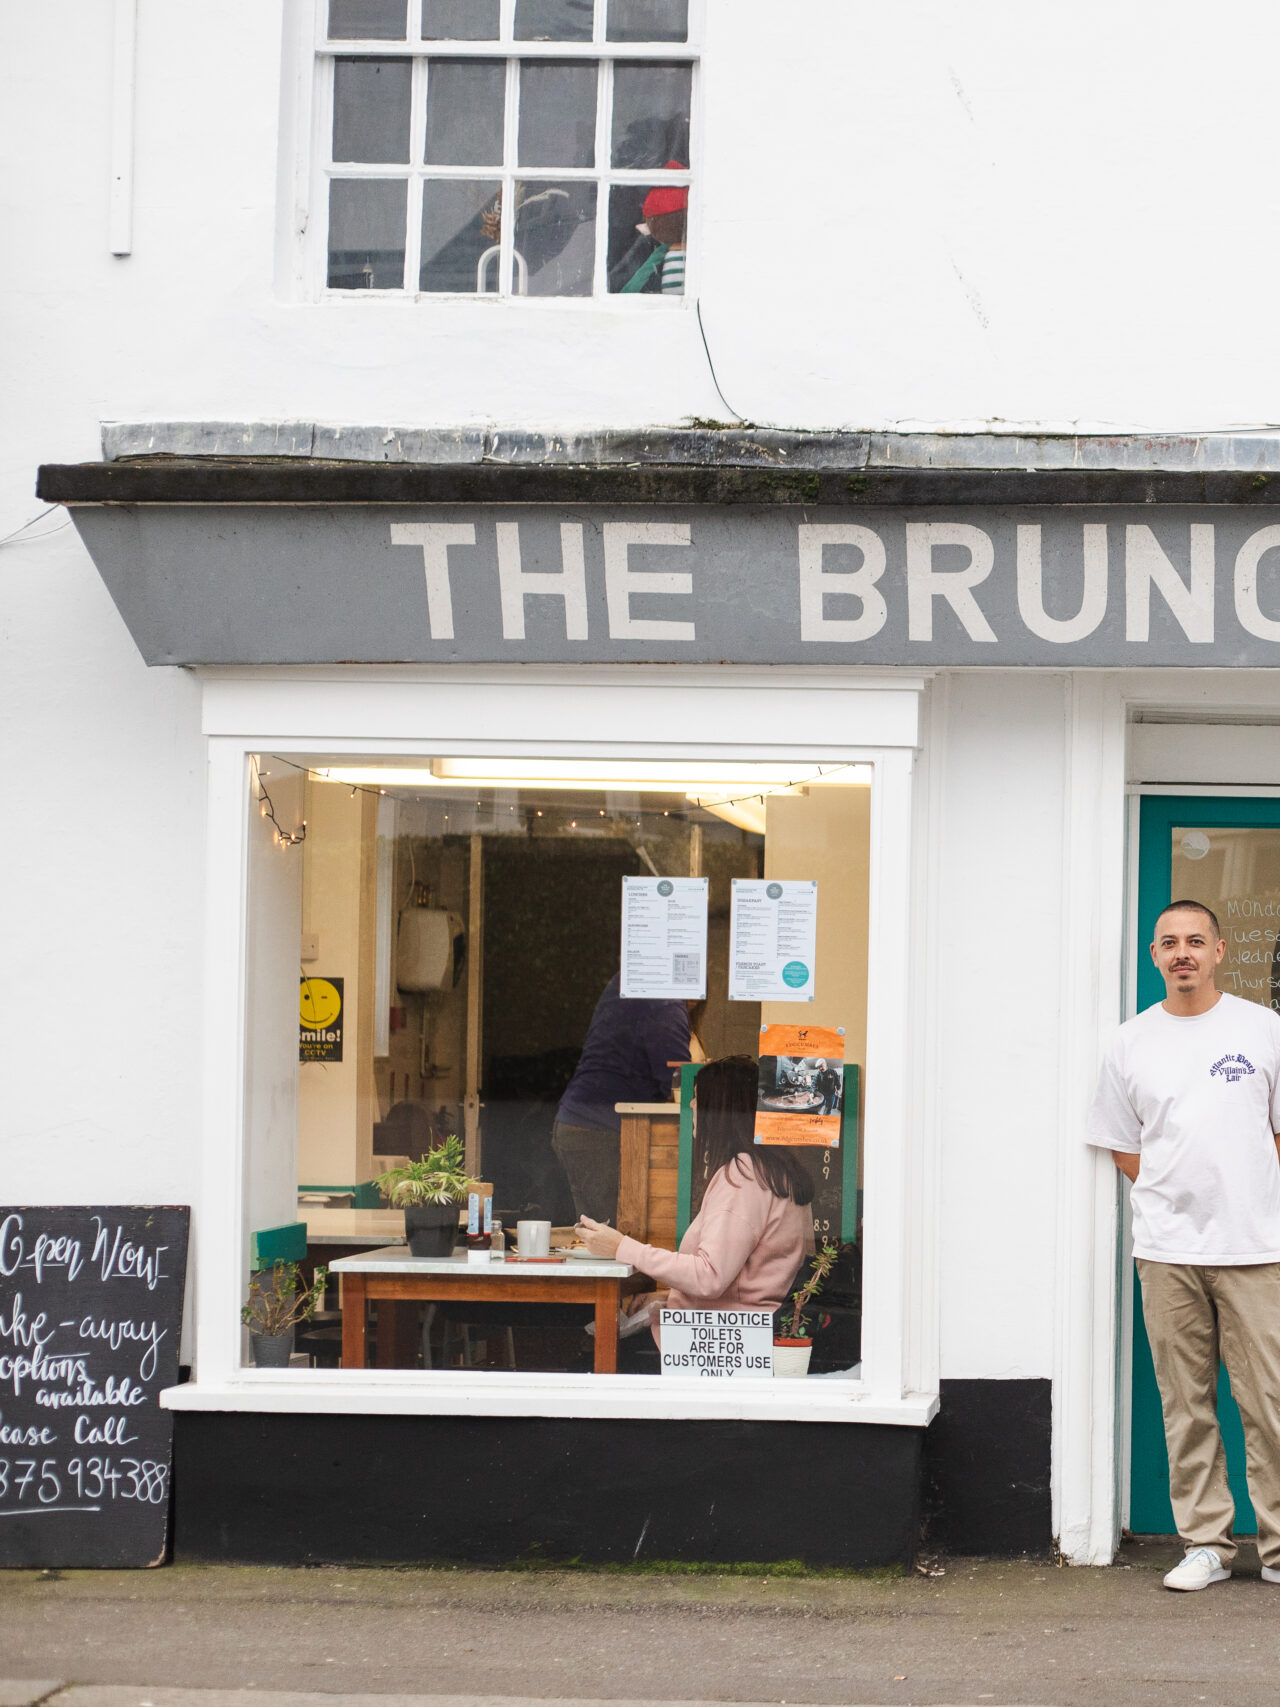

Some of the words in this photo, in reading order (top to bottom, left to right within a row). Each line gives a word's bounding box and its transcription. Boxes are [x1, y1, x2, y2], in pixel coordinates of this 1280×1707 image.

[390, 522, 695, 640] THE
[299, 1029, 341, 1042] mile!
[1210, 1054, 1235, 1077] Atlantic
[1235, 1053, 1256, 1075] Beach
[1226, 1074, 1241, 1083] Lair
[823, 1150, 831, 1164] 8
[822, 1166, 830, 1180] 9
[0, 1214, 83, 1283] Open
[91, 1216, 169, 1290] Now
[662, 1311, 713, 1325] POLITE
[717, 1312, 770, 1326] NOTICE
[691, 1328, 742, 1341] TOILETS
[689, 1342, 715, 1354] ARE
[719, 1342, 744, 1355] FOR
[663, 1354, 741, 1368] CUSTOMERS
[746, 1356, 771, 1369] USE
[0, 1345, 96, 1396] options
[36, 1376, 147, 1409] available
[0, 1420, 58, 1446] ease
[74, 1414, 138, 1446] Call
[67, 1457, 168, 1503] 934388
